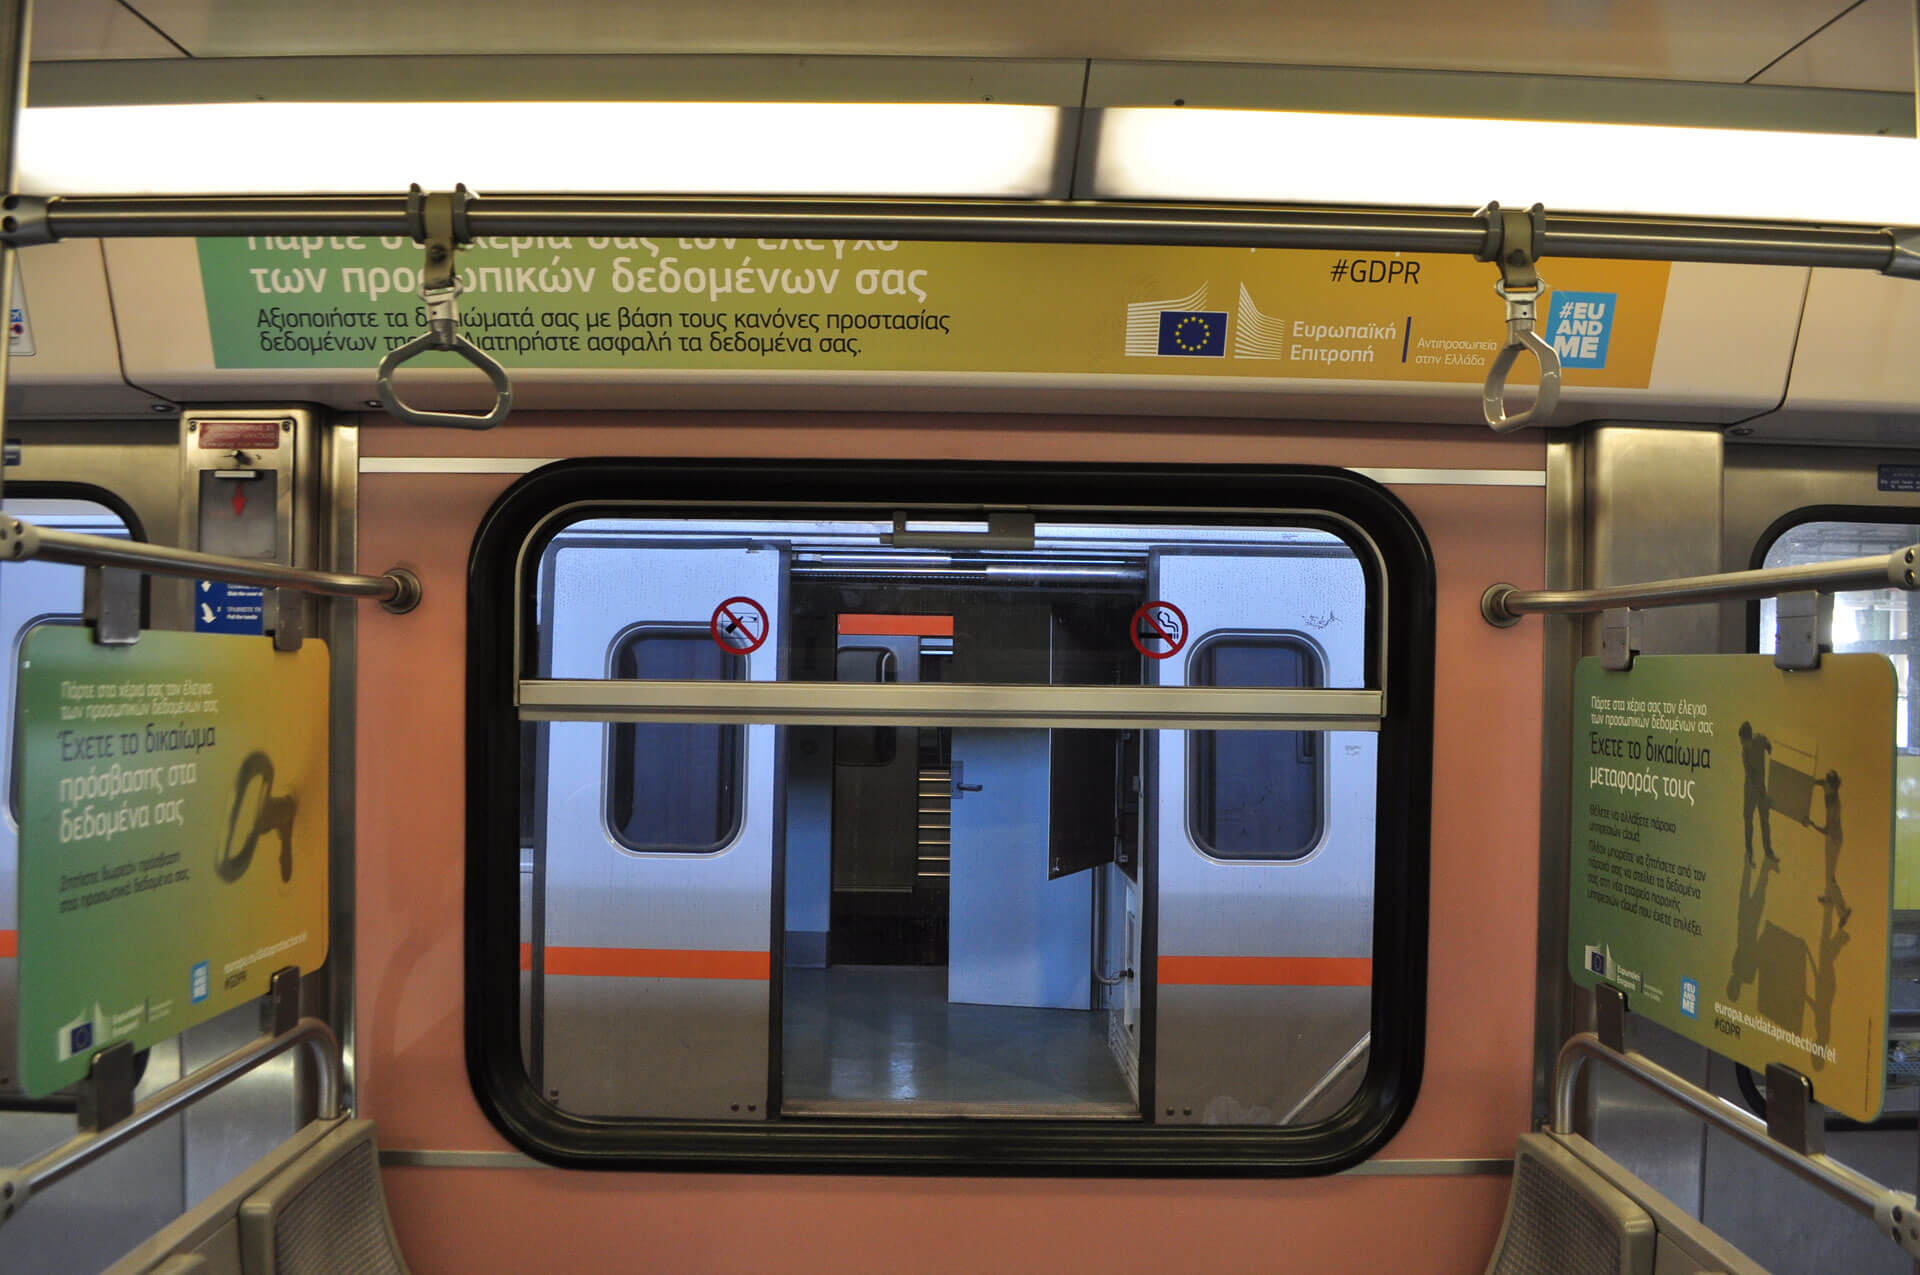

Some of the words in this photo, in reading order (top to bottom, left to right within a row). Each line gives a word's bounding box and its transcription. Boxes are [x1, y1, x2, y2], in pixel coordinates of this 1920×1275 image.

[249, 267, 327, 294] των
[611, 256, 840, 303] δεδομένων
[855, 268, 928, 303] σας
[1330, 259, 1421, 284] #GDPR
[256, 305, 380, 332] Αξιοποιήστε
[384, 311, 409, 328] τα
[415, 305, 534, 332] διώματά
[540, 311, 580, 333] σας
[584, 312, 613, 333] με
[617, 305, 672, 331] βάση
[678, 312, 728, 333] τους
[734, 306, 821, 334] κανόνες
[826, 308, 952, 336] προστασίας
[1559, 301, 1606, 320] #EU
[1291, 320, 1399, 342] Ευρωπαϊκή
[1555, 319, 1604, 336] AND
[259, 331, 379, 357] δεδομένων
[383, 335, 418, 351] τη
[586, 331, 673, 357] ασφαλή
[677, 335, 703, 352] τα
[709, 331, 812, 357] δεδομένα
[818, 337, 863, 358] σας.
[1290, 344, 1377, 366] Επιτροπή
[1416, 337, 1499, 353] Αντιπροσωπεία
[1553, 335, 1600, 359] ME
[1415, 353, 1441, 366] στην
[1444, 352, 1487, 368] Ελλάδα
[1592, 696, 1612, 713] Πάρτε
[1628, 697, 1646, 713] χέρια
[1647, 702, 1662, 716] σας
[1662, 701, 1676, 714] τον
[1679, 700, 1707, 718] έλεγχο
[1652, 715, 1695, 734] δεδομένων
[1698, 721, 1714, 736] σας
[58, 729, 114, 762] Έχετε
[120, 733, 139, 756] το
[145, 722, 215, 754] δικαίωμα
[1589, 732, 1624, 759] Έχετε
[1627, 740, 1642, 759] το
[1646, 736, 1711, 773] δικαίωμα
[61, 764, 163, 807] πρόσβασης
[168, 763, 197, 786] στα
[1590, 766, 1659, 800] μεταφοράς
[1663, 777, 1696, 807] τους
[61, 801, 149, 842] δεδομένα
[155, 799, 184, 825] σας
